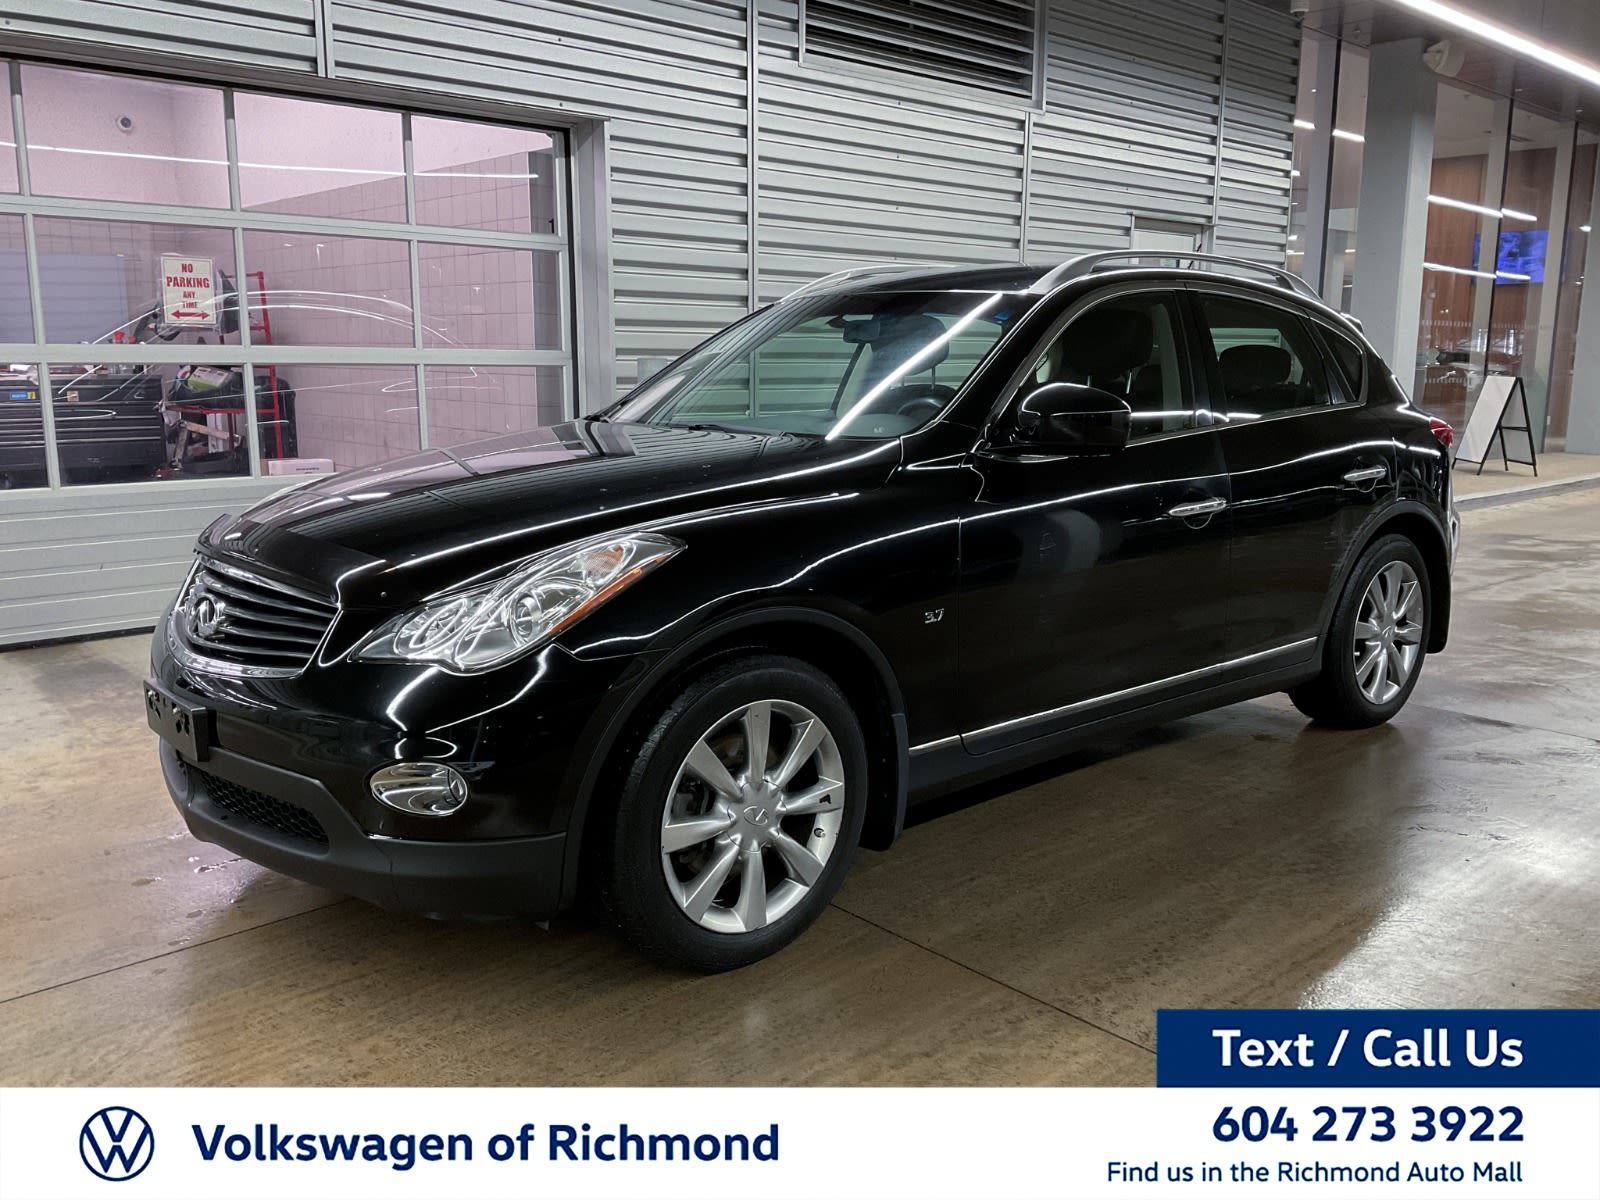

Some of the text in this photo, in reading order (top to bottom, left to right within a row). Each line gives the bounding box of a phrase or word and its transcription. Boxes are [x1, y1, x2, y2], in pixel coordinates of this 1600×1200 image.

[181, 263, 194, 273] NO
[166, 276, 210, 289] PARKING
[182, 290, 196, 299] ANY
